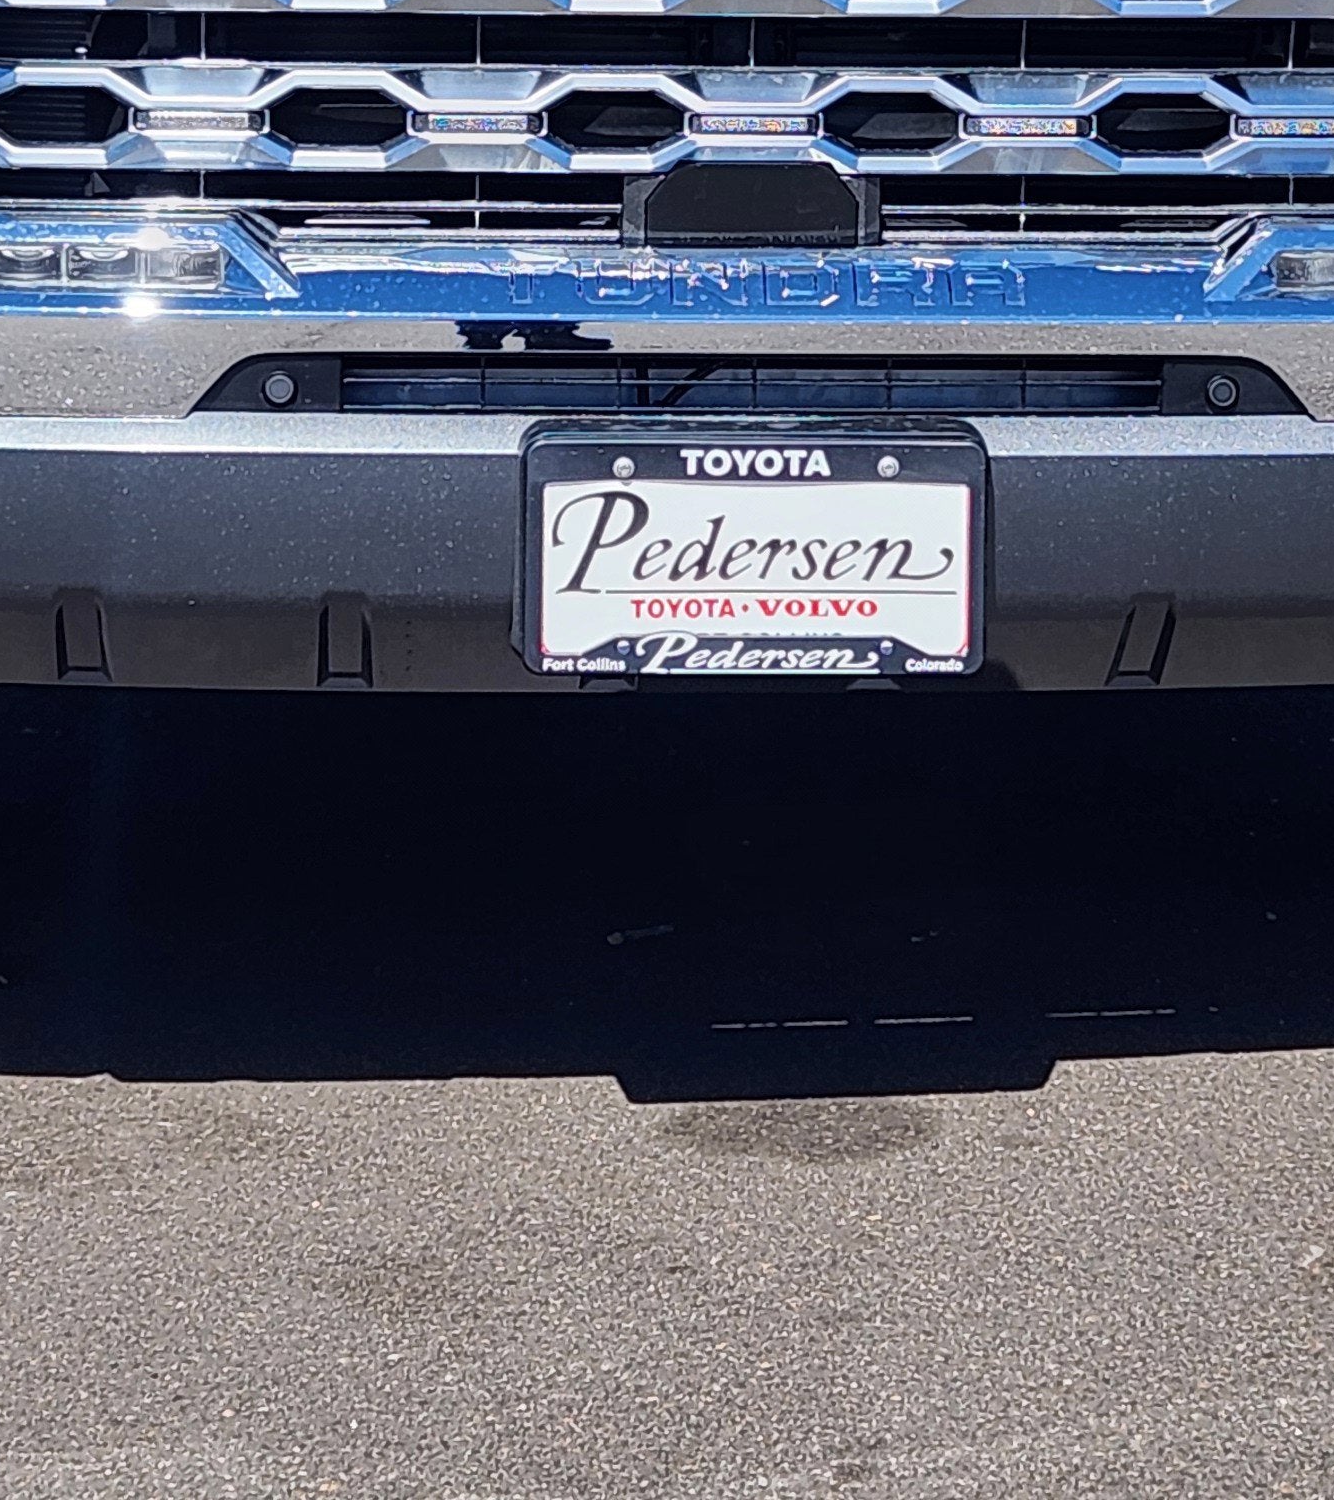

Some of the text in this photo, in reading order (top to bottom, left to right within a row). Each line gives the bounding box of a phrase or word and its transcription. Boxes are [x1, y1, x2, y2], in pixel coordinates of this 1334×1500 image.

[497, 260, 1026, 306] TUNDRA
[679, 449, 832, 477] TOYOTA
[551, 491, 955, 593] Pedersen
[630, 599, 878, 619] TOYOTA VOLVO
[542, 657, 626, 672] Fort Collins
[636, 631, 880, 674] Pedersen
[905, 658, 964, 672] Colorado
